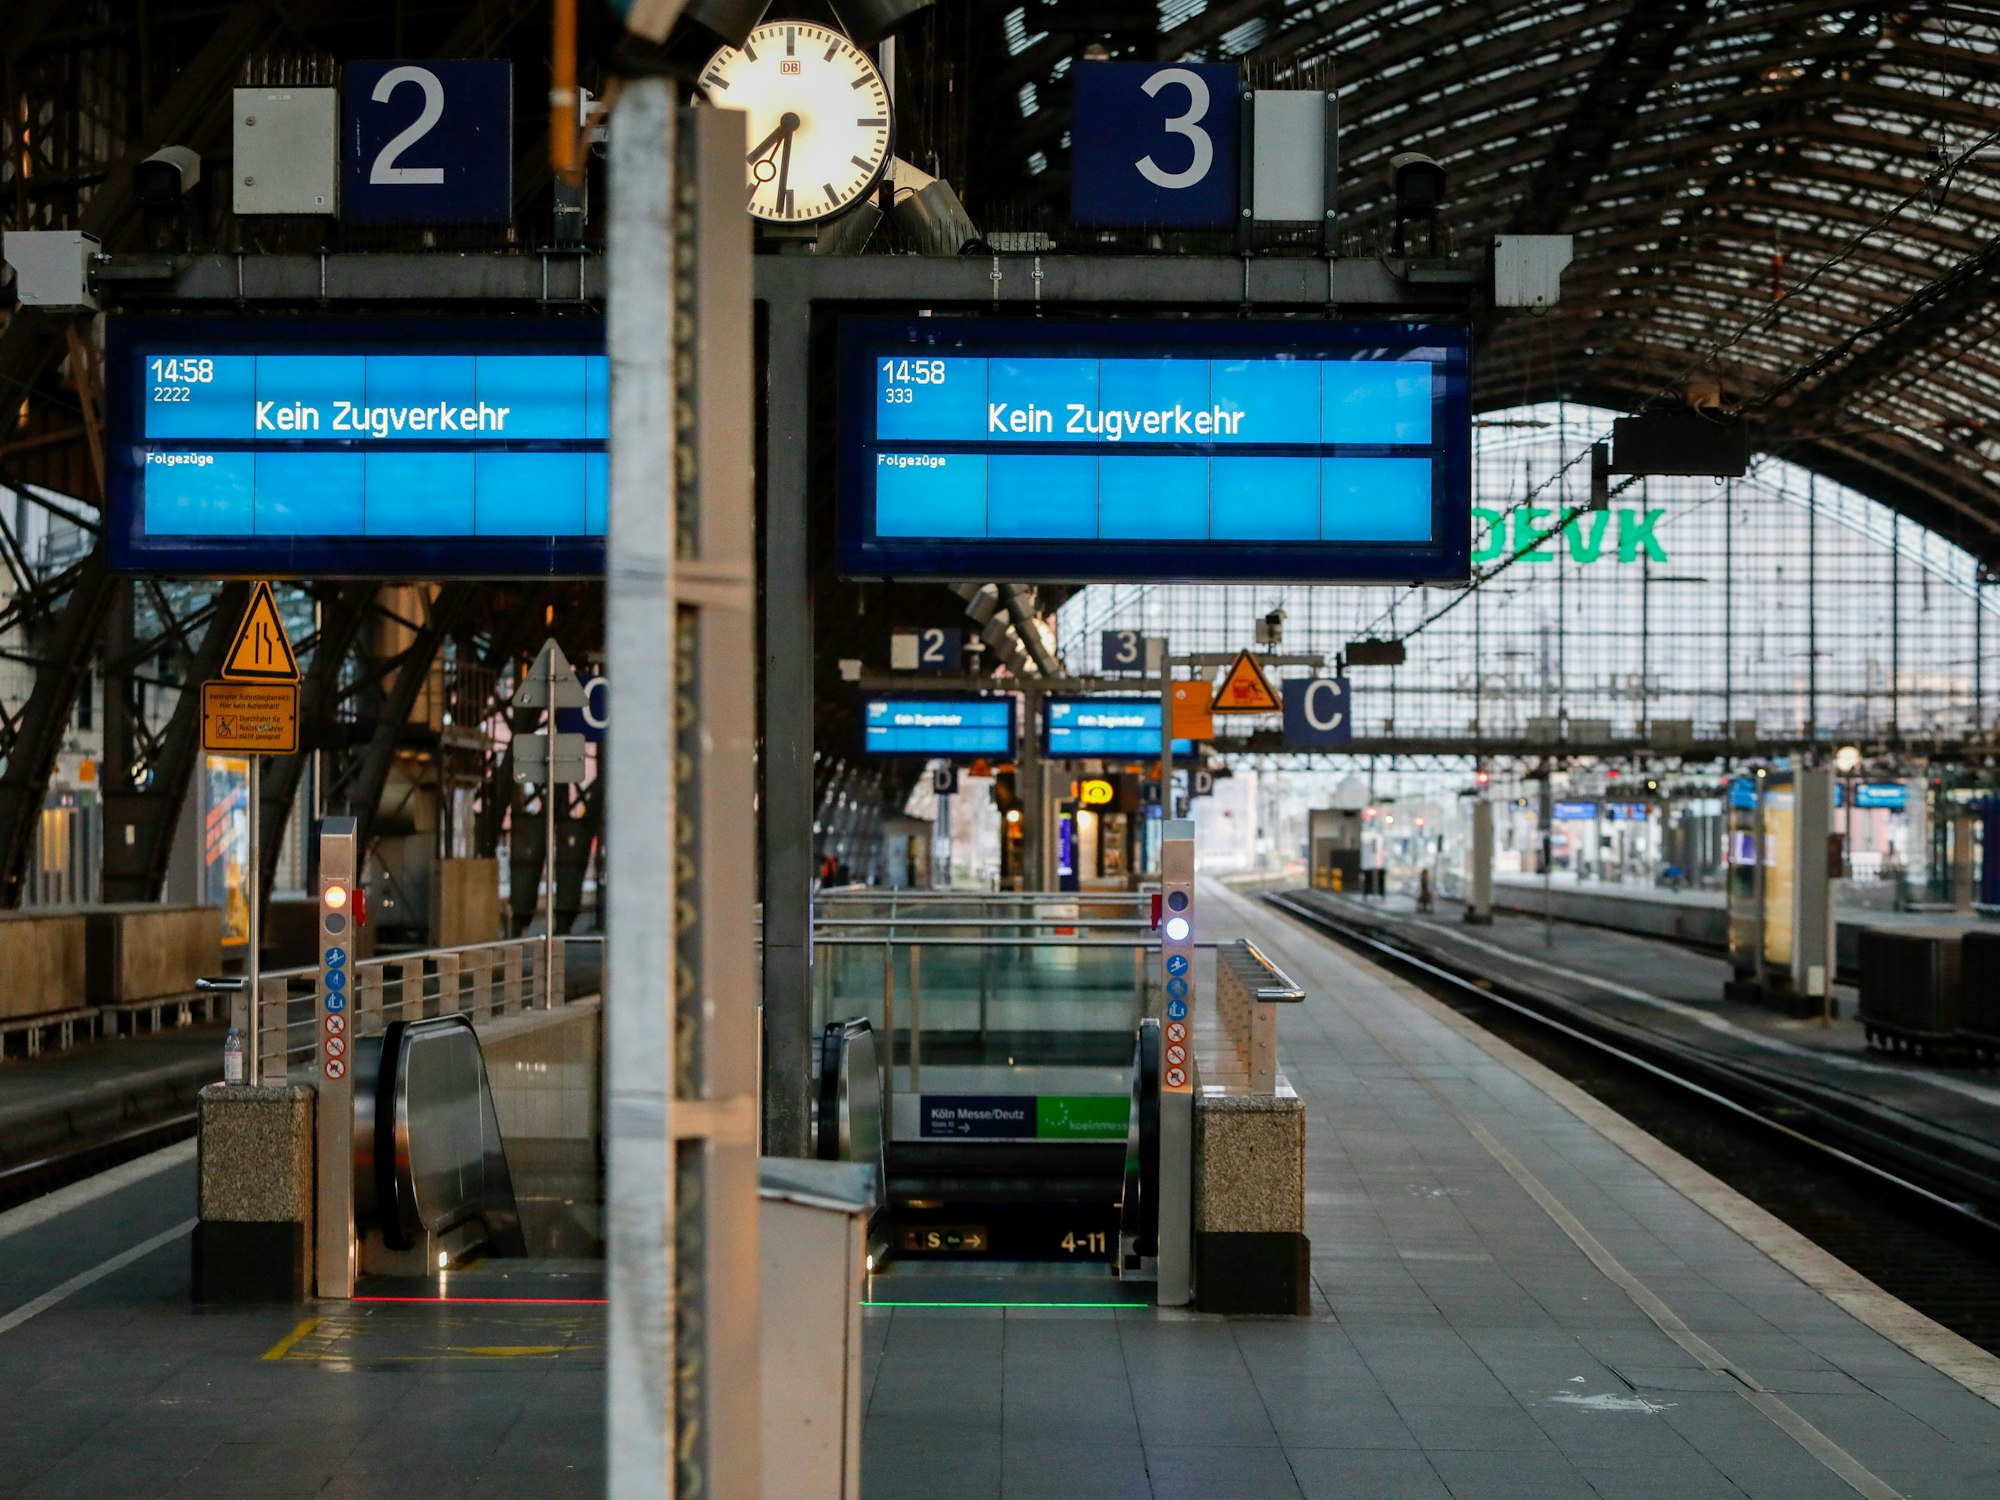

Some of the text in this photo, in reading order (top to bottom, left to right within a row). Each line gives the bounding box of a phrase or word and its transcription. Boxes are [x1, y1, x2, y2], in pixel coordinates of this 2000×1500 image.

[783, 63, 798, 73] DB
[369, 66, 445, 185] 2
[1134, 68, 1214, 189] 3
[151, 358, 214, 383] 14:58
[882, 360, 946, 385] 14:58
[154, 386, 190, 402] 2222
[885, 388, 913, 403] 333
[255, 401, 510, 438] Kein Zugverkehr
[988, 403, 1246, 441] Kein Zugverkehr
[146, 453, 214, 467] Folgezüge
[878, 454, 946, 468] Folgezüge
[922, 628, 945, 662] 2
[1115, 631, 1138, 663] 3
[1304, 679, 1343, 731] C
[935, 769, 951, 790] D
[1196, 771, 1212, 793] D
[931, 1107, 1025, 1119] Köln Messe/Deutz
[1069, 1119, 1129, 1131] koelnmess
[927, 1231, 941, 1248] S
[1061, 1231, 1106, 1253] 4-11
